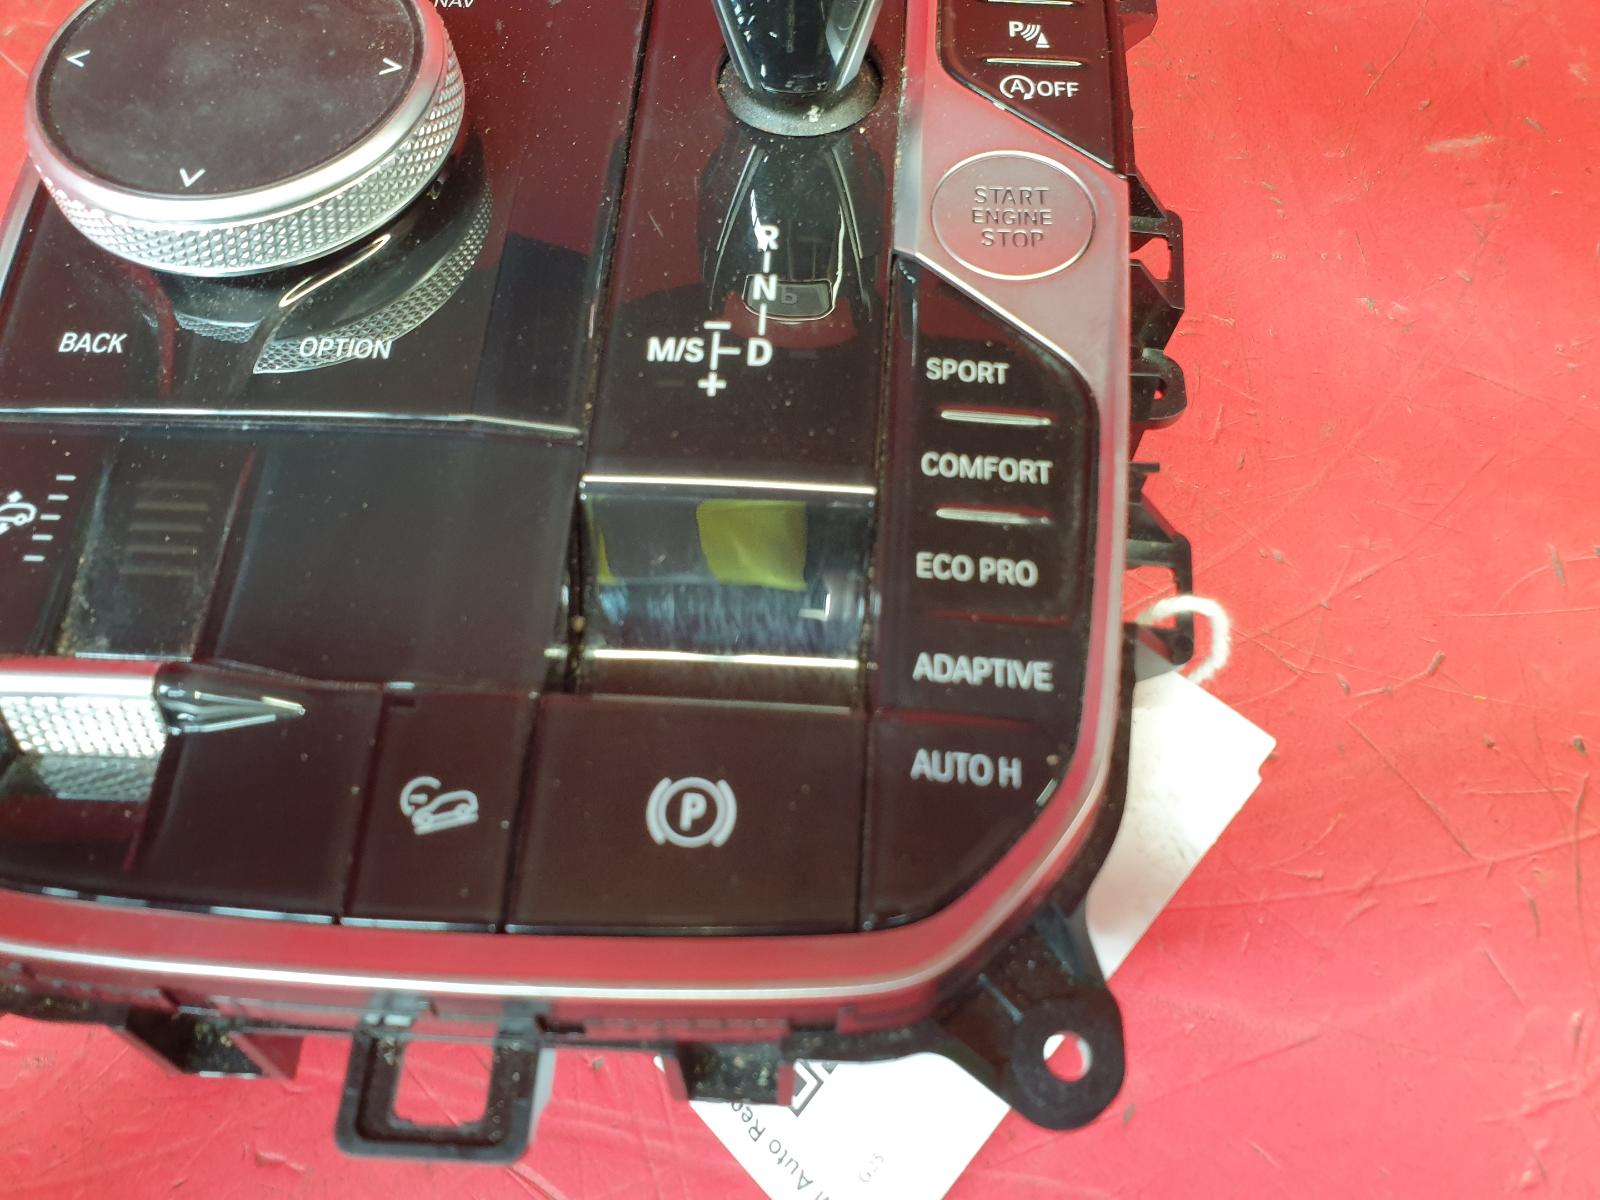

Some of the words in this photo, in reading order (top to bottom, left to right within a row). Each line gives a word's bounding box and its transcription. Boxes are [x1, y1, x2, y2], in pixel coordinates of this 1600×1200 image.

[1036, 80, 1080, 98] OFF
[974, 186, 1050, 205] START
[971, 207, 1053, 226] ENGINE
[757, 224, 780, 251] R
[981, 228, 1044, 248] STOP
[752, 273, 778, 301] N
[58, 331, 128, 354] BACK
[299, 336, 393, 360] OPTION
[646, 336, 705, 363] M/S
[746, 337, 774, 367] D
[925, 356, 1010, 386] SPORT
[920, 450, 1054, 486] COMFORT
[915, 551, 975, 582] ECO
[979, 555, 1039, 588] PRO
[911, 652, 1055, 693] ADAPTIVE
[910, 748, 994, 786] AUTO
[997, 757, 1023, 790] H
[769, 1139, 814, 1190] Auto
